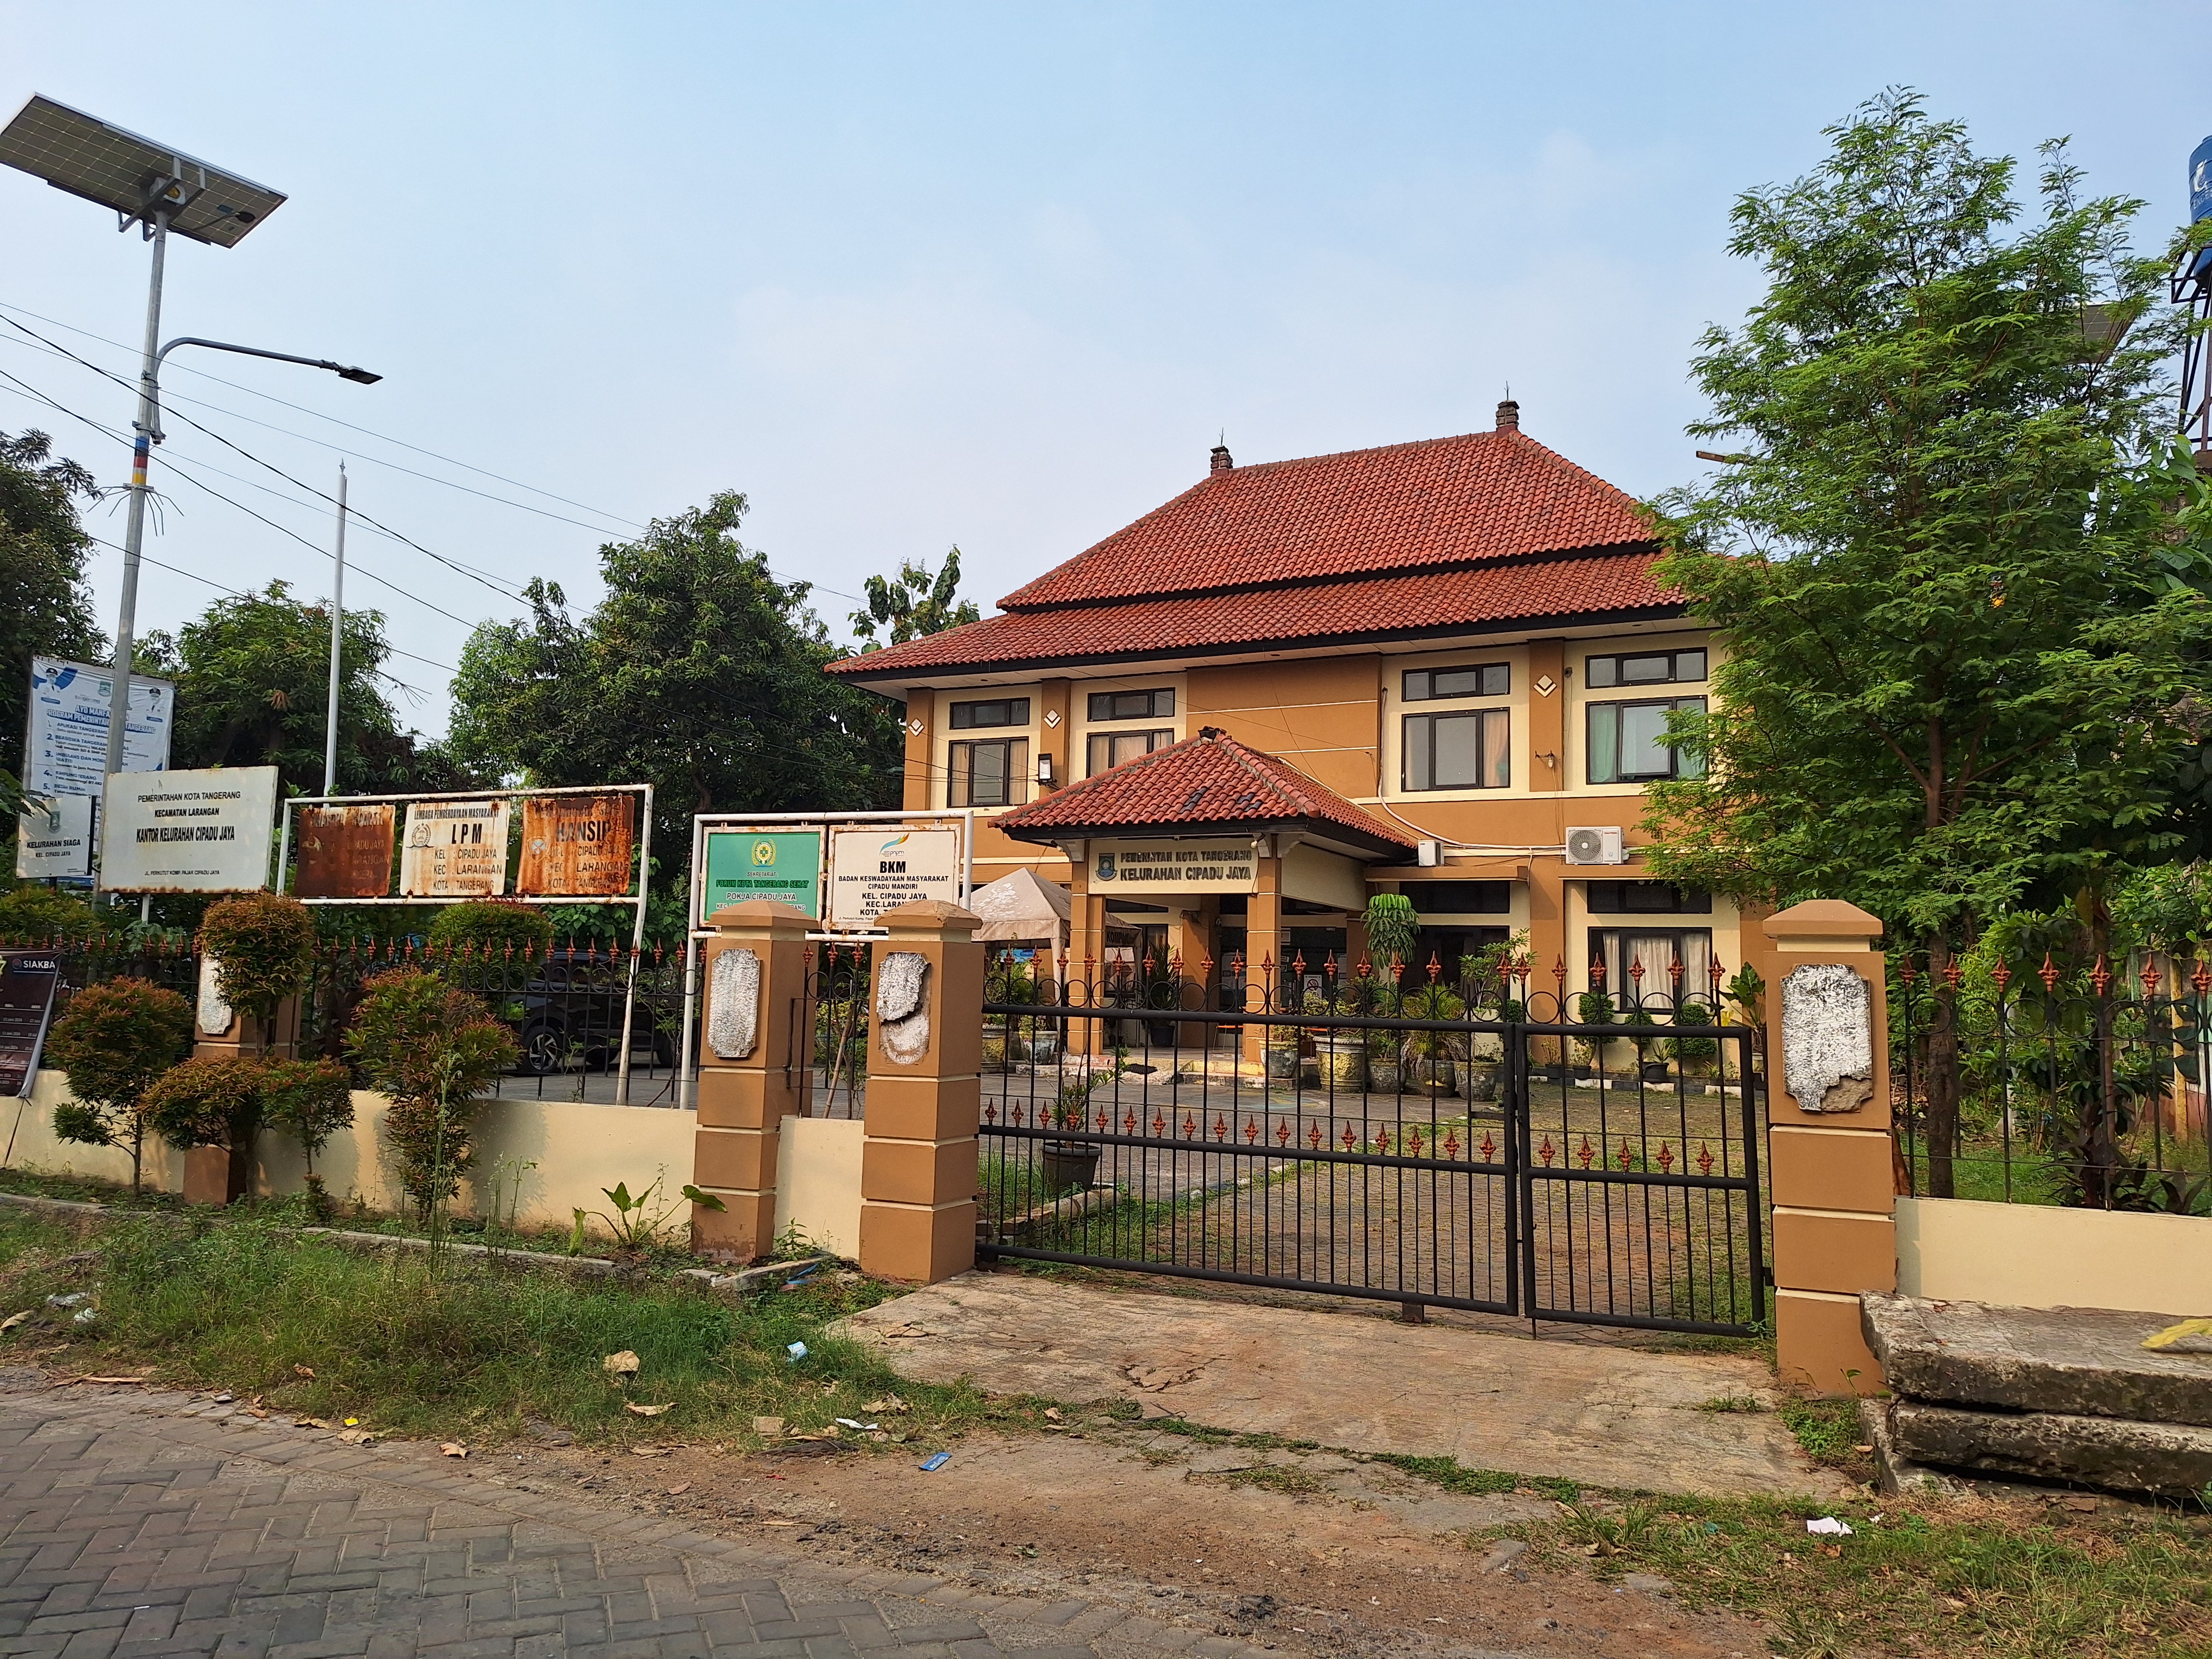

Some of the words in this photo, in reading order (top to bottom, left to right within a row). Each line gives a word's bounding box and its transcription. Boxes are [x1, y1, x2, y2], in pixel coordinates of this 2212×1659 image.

[138, 793, 182, 802] PEMERINTAHAN
[184, 792, 201, 800] KOTA
[201, 791, 241, 800] TANGERANG
[155, 808, 187, 818] KECAMATAN
[188, 807, 220, 816] LARANGAN
[414, 809, 434, 820] LEMBAGA
[136, 827, 158, 843] KANTOR
[160, 827, 195, 842] KELURAHAN
[195, 826, 218, 841] CIPADU
[219, 826, 235, 841] JAYA
[556, 820, 612, 843] HANSIP
[27, 840, 62, 848] KELURAHAN
[458, 848, 480, 859] CIPADU
[481, 848, 497, 859] JAYA
[1121, 851, 1172, 863] PEMERINTAH
[1176, 851, 1198, 863] KOTA
[1201, 850, 1252, 861] TANGERANG
[434, 865, 446, 874] KEC
[456, 864, 502, 874] LARANGAN
[880, 861, 906, 873] BKM
[1121, 867, 1181, 881] KELURAHAN
[1186, 866, 1224, 881] CIPADU
[1226, 866, 1251, 880] JAYA
[433, 879, 448, 890] KOTA
[456, 880, 494, 890] TANGERANG
[716, 879, 736, 888] FORUM
[754, 880, 788, 888] TANGERANG
[789, 880, 809, 888] SEHAT
[23, 960, 55, 969] SIAKBA
